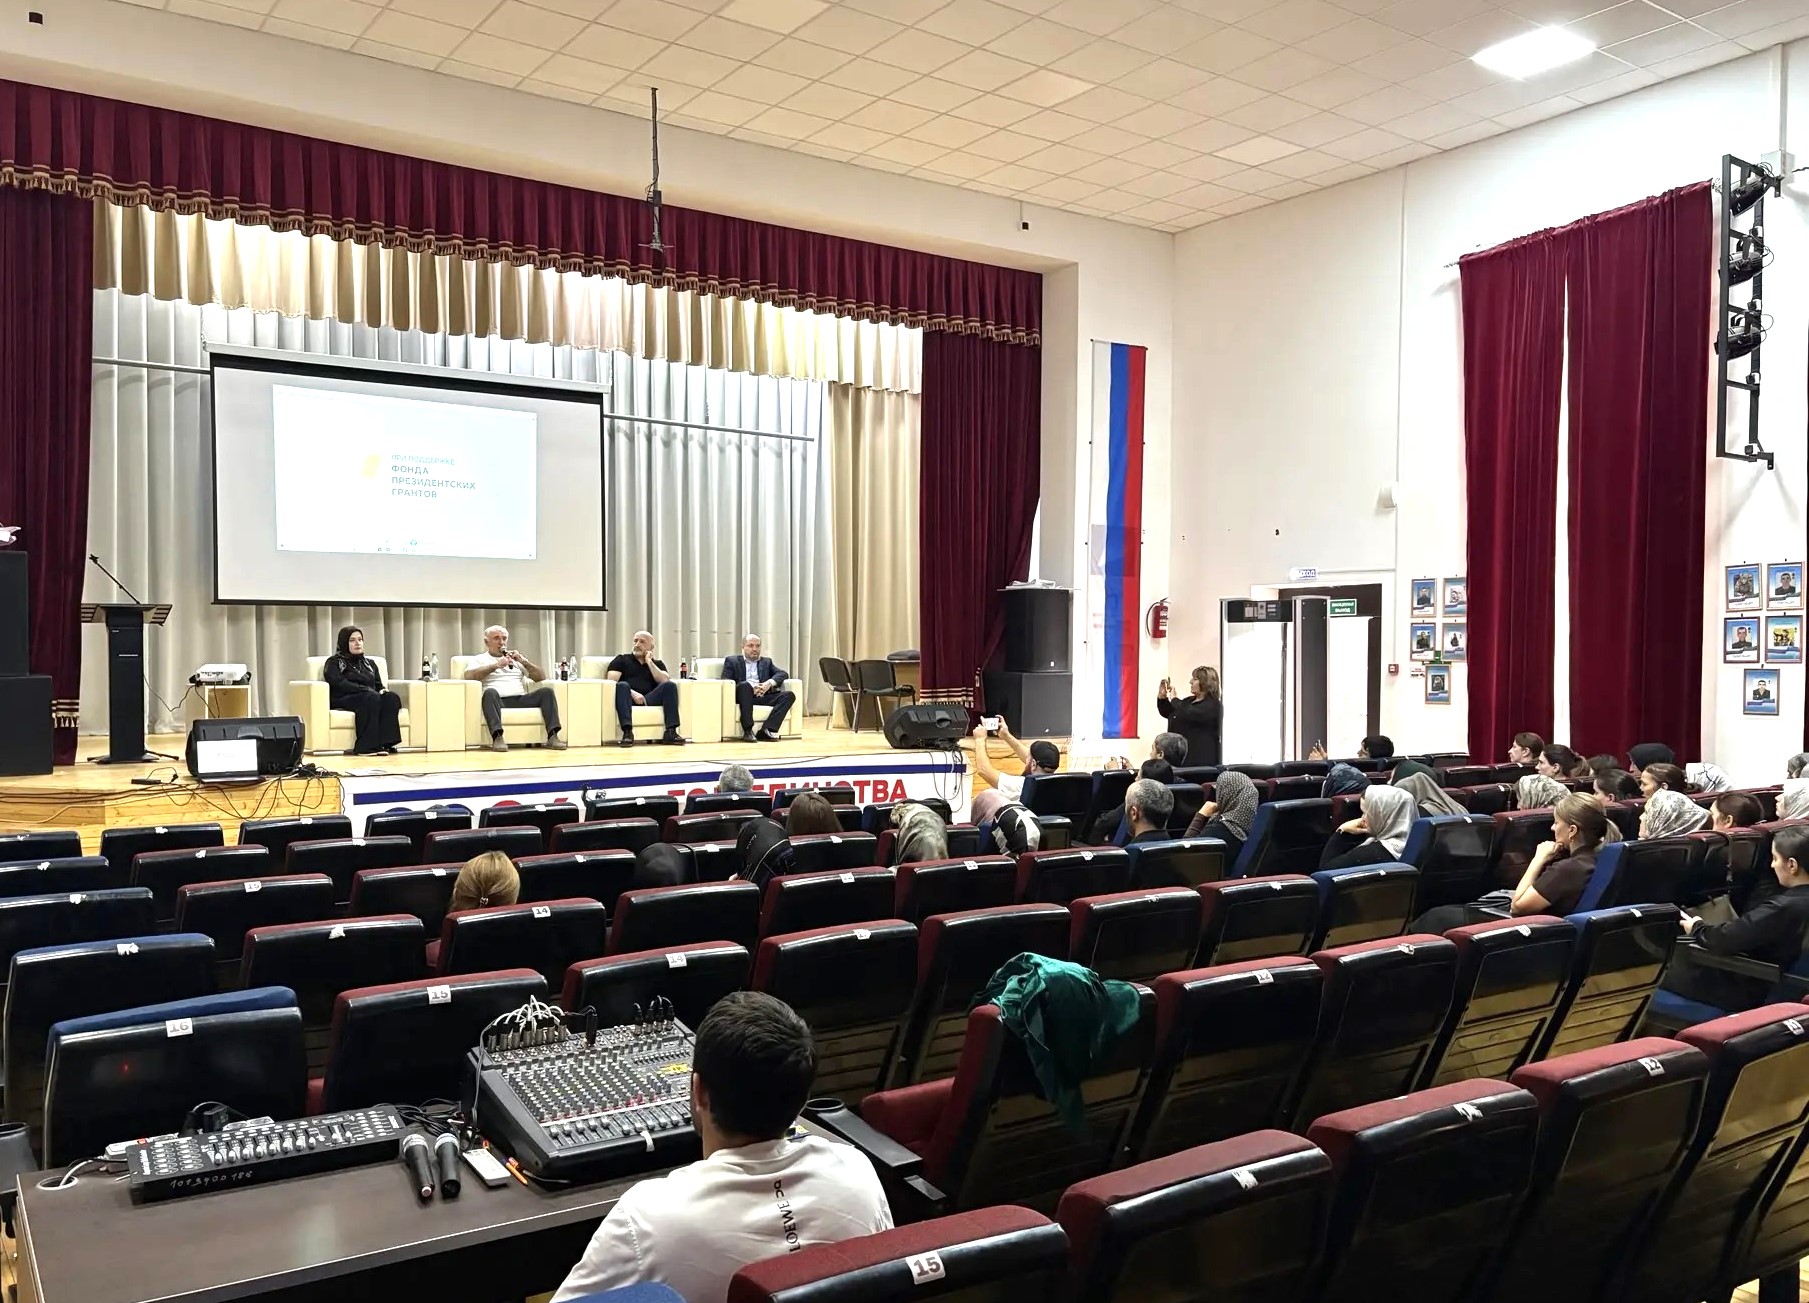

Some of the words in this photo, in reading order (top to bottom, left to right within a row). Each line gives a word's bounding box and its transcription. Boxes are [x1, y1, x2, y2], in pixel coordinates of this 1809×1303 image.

[391, 465, 429, 475] ФОНДА
[391, 476, 476, 490] ПРЕЗИДЕНТСКИХ
[391, 488, 437, 498] ГРАНТОВ
[535, 907, 548, 915] 14
[669, 954, 684, 964] 14
[431, 990, 449, 1000] 15
[169, 1021, 190, 1033] 16
[1644, 1058, 1661, 1071] 12
[777, 1200, 801, 1253] LOEWE
[913, 1256, 941, 1277] 15
